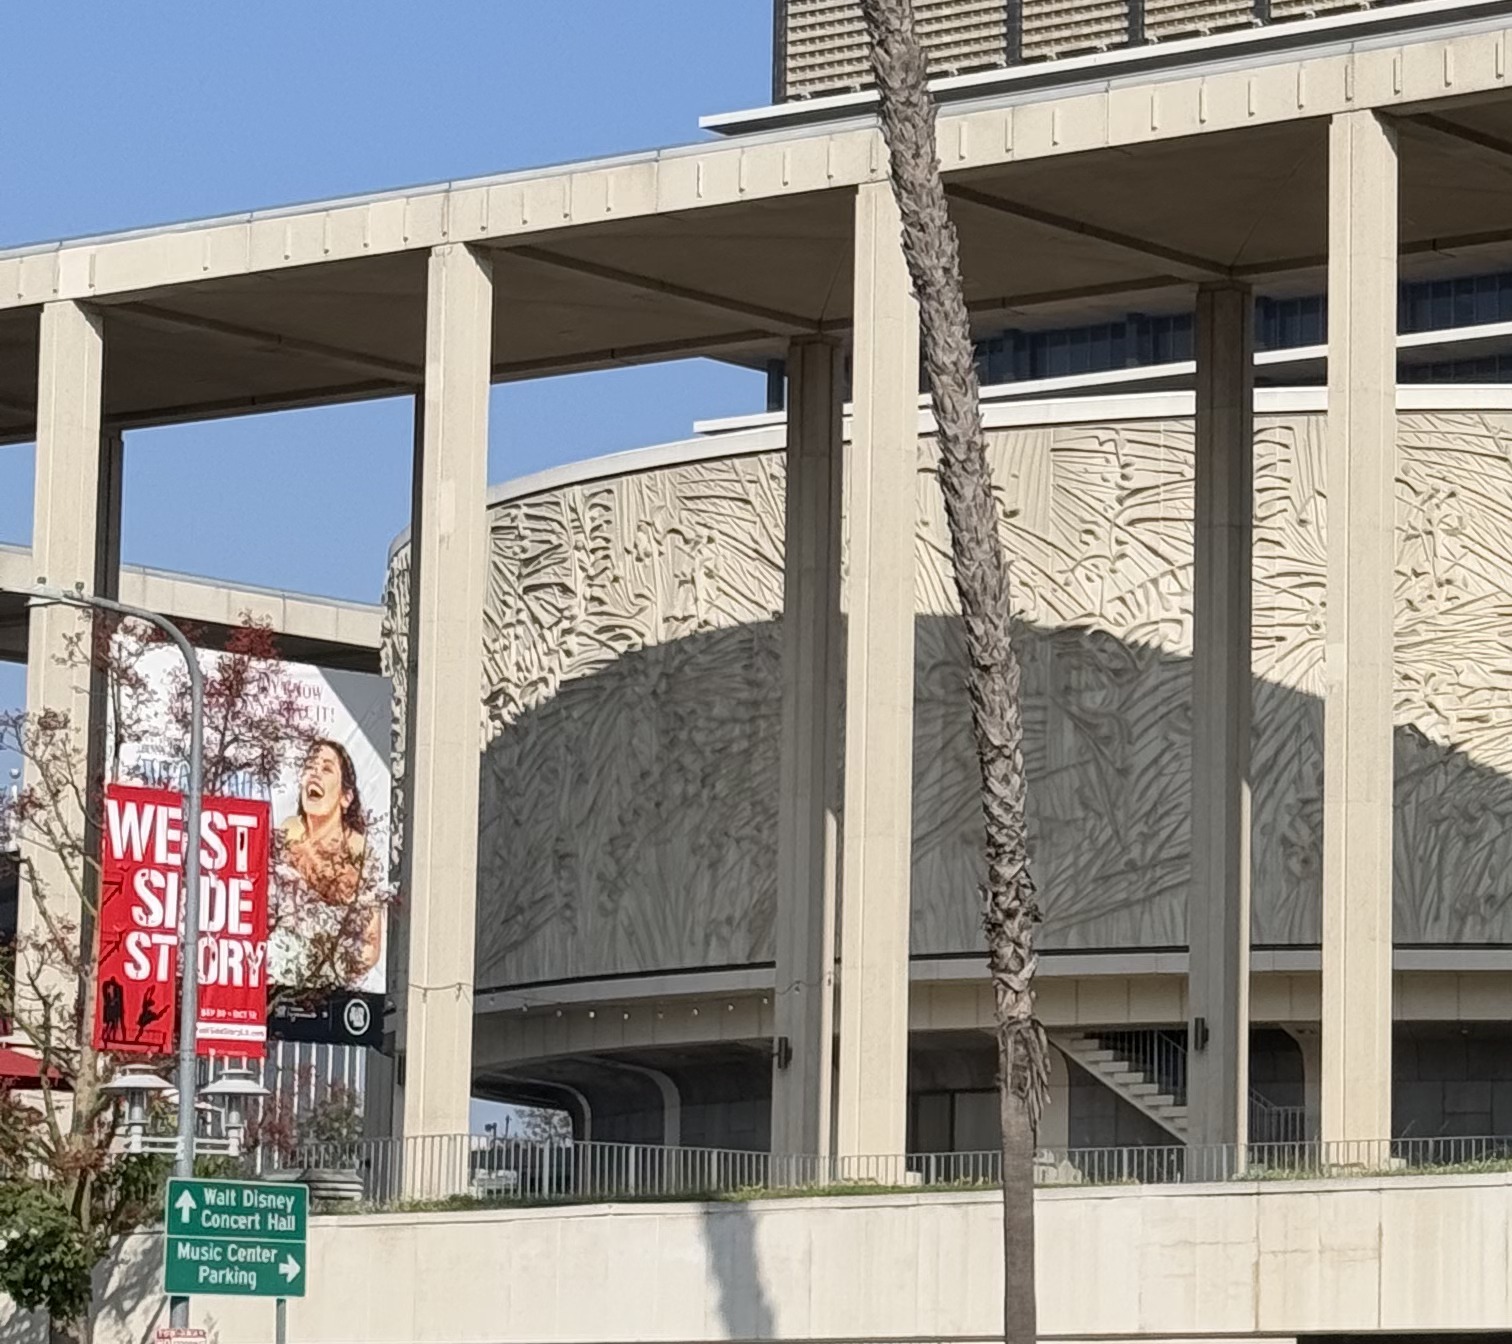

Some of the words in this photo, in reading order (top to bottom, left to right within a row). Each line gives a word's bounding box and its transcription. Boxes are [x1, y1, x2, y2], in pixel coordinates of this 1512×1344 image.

[107, 799, 258, 873] WEST
[131, 868, 254, 935] SIDE
[123, 930, 267, 988] STORY
[203, 1187, 237, 1206] Walt
[242, 1189, 295, 1213] Disney
[201, 1209, 260, 1230] Concert
[267, 1213, 296, 1231] Hall
[177, 1241, 223, 1261] Music
[227, 1243, 278, 1263] Center
[198, 1265, 257, 1290] Parking
